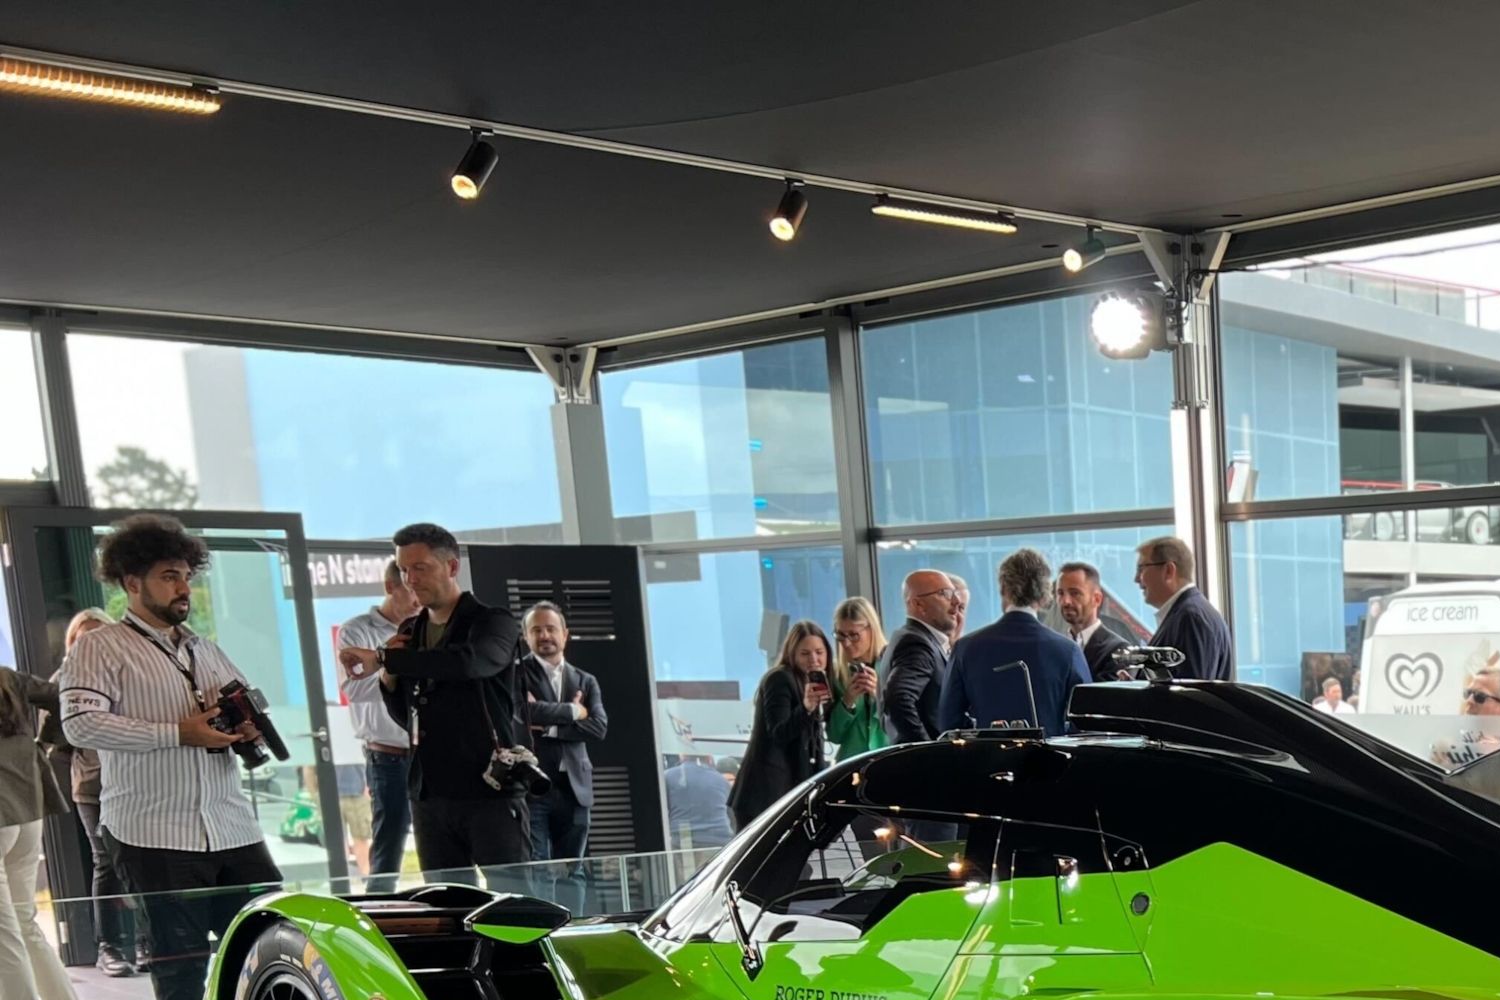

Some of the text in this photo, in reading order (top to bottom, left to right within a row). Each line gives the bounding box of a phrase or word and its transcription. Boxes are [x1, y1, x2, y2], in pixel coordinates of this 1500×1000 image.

[328, 553, 344, 585] N
[1407, 605, 1479, 622] ice cream
